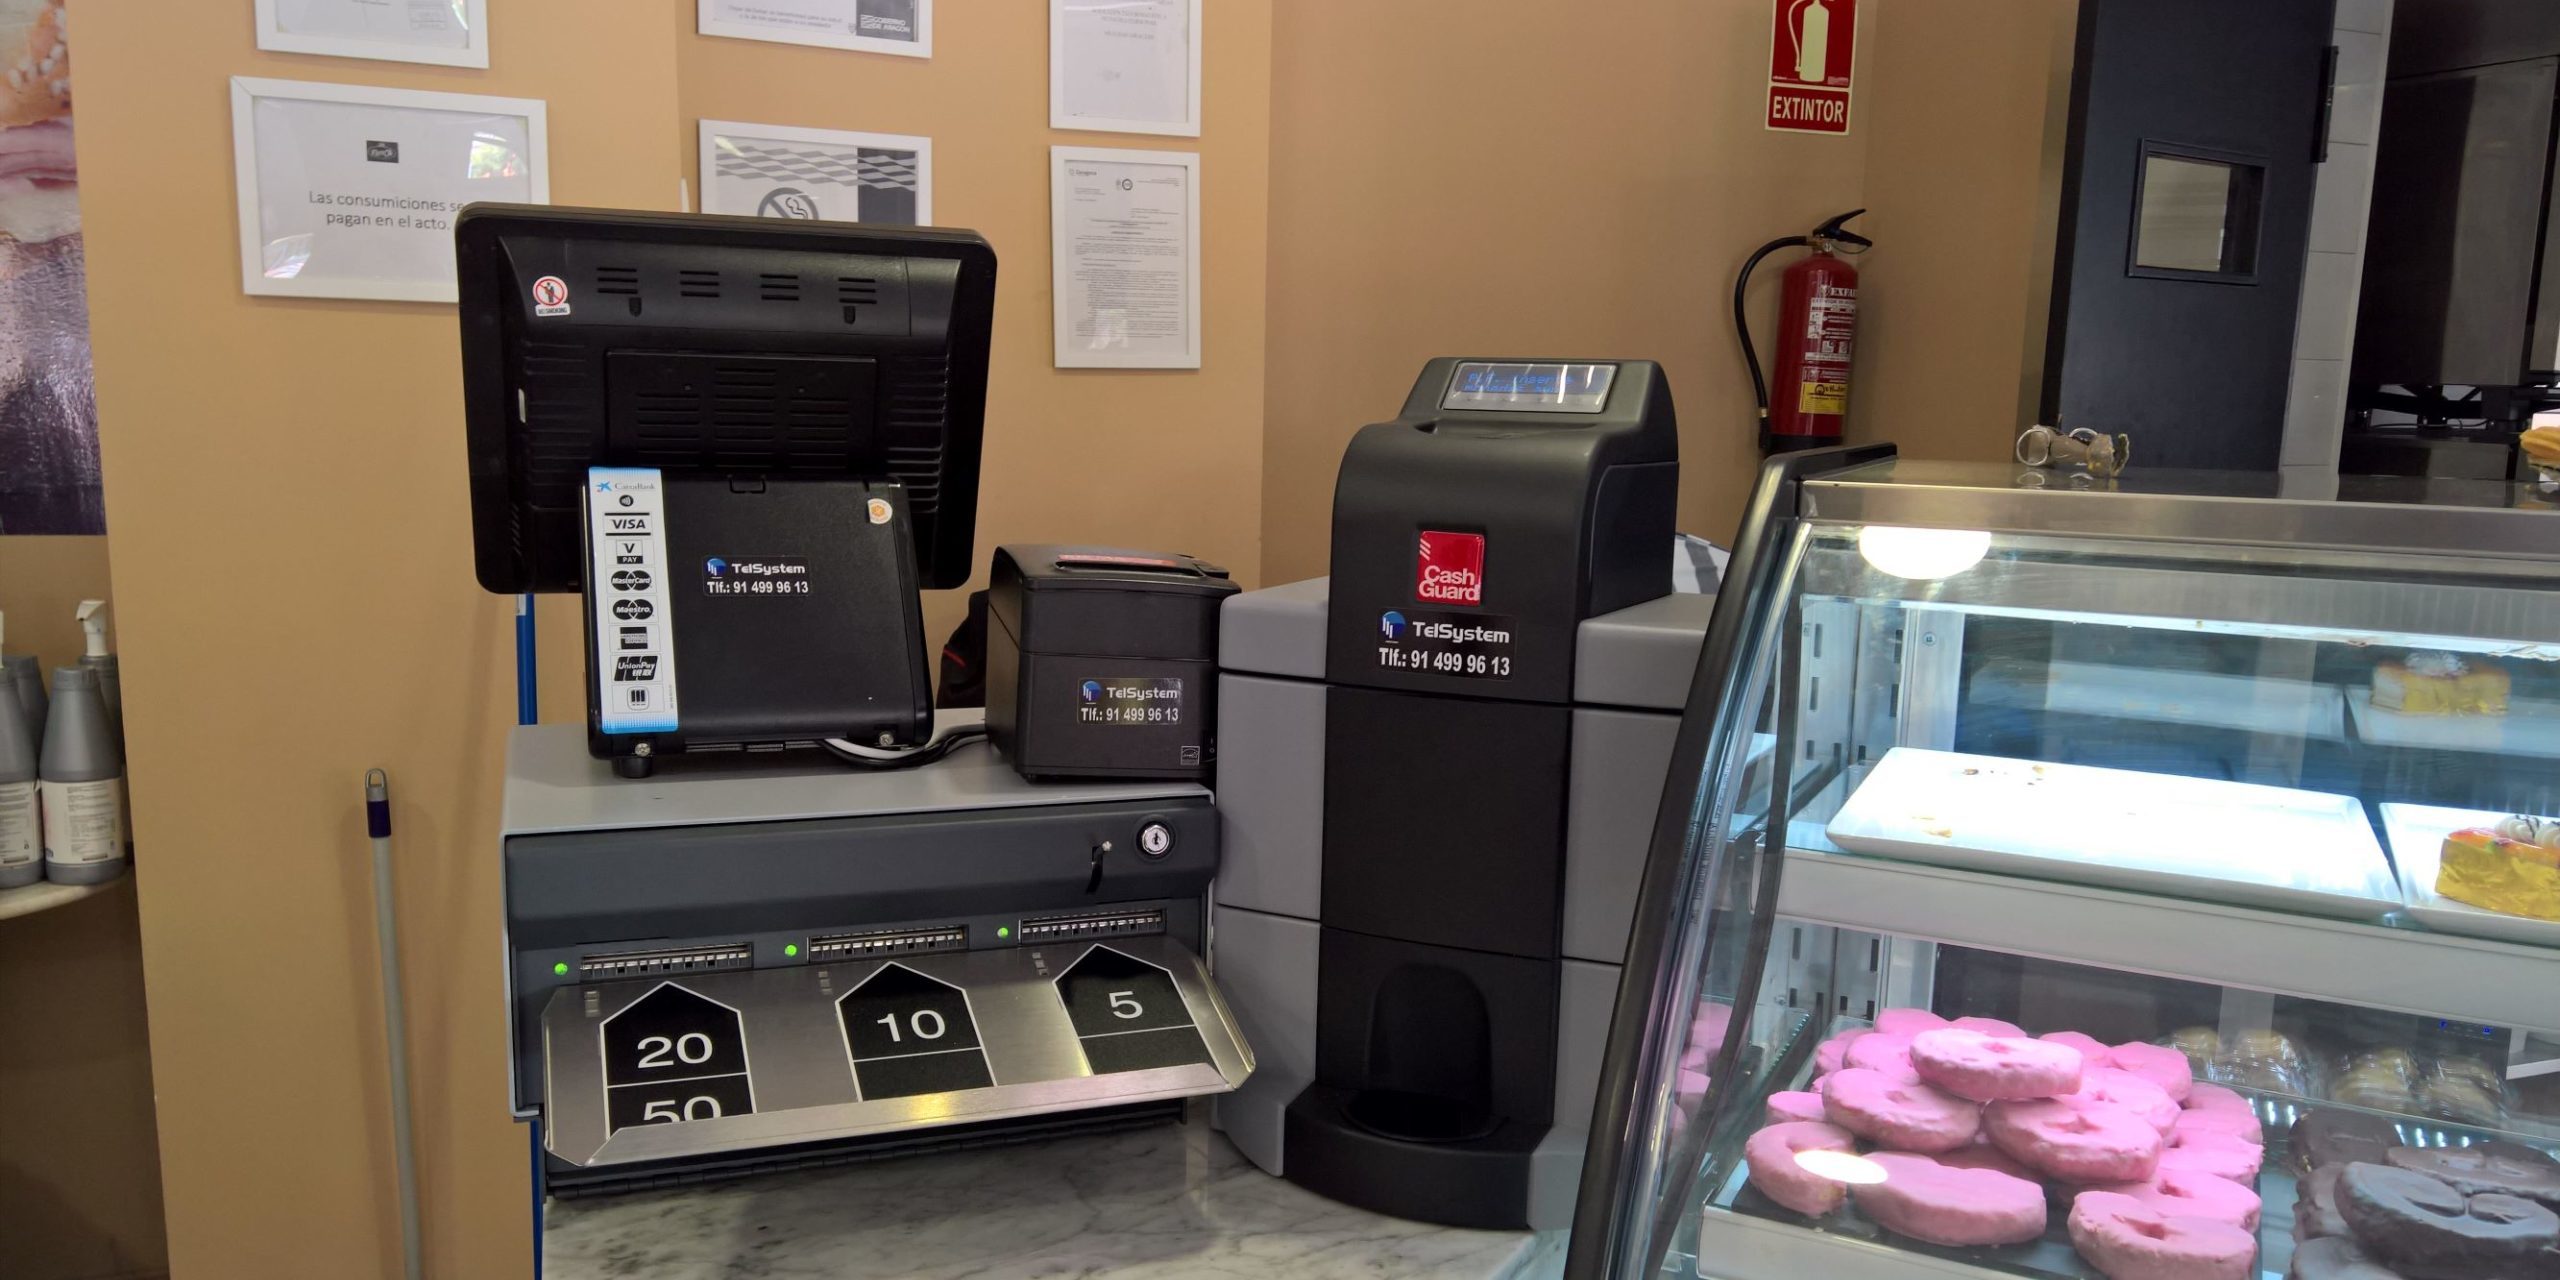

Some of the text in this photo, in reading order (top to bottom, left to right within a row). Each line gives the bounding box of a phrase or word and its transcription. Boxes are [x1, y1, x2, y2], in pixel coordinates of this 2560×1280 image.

[1772, 95, 1845, 124] EXTINTOR
[309, 190, 333, 204] Las
[337, 193, 446, 212] consumiciones
[326, 212, 451, 231] pagan en el acto.
[611, 519, 646, 530] VISA
[623, 543, 636, 554] V
[622, 556, 638, 564] PAY
[731, 563, 806, 576] TelSystem
[612, 577, 651, 585] MasterCard
[1424, 565, 1475, 586] Cash
[707, 581, 809, 593] Tlf.: 91 499 96 13
[1418, 580, 1481, 601] Guard
[616, 606, 650, 614] Maestro
[1412, 621, 1510, 643] TelSystem
[1379, 647, 1510, 676] Tlf.: 91 499 96 13
[1106, 687, 1178, 701] TelSystem
[1081, 707, 1179, 721] Tlf.: 91 499 96 13
[1108, 990, 1143, 1020] 5
[876, 1009, 946, 1042] 10
[637, 1032, 713, 1069] 20
